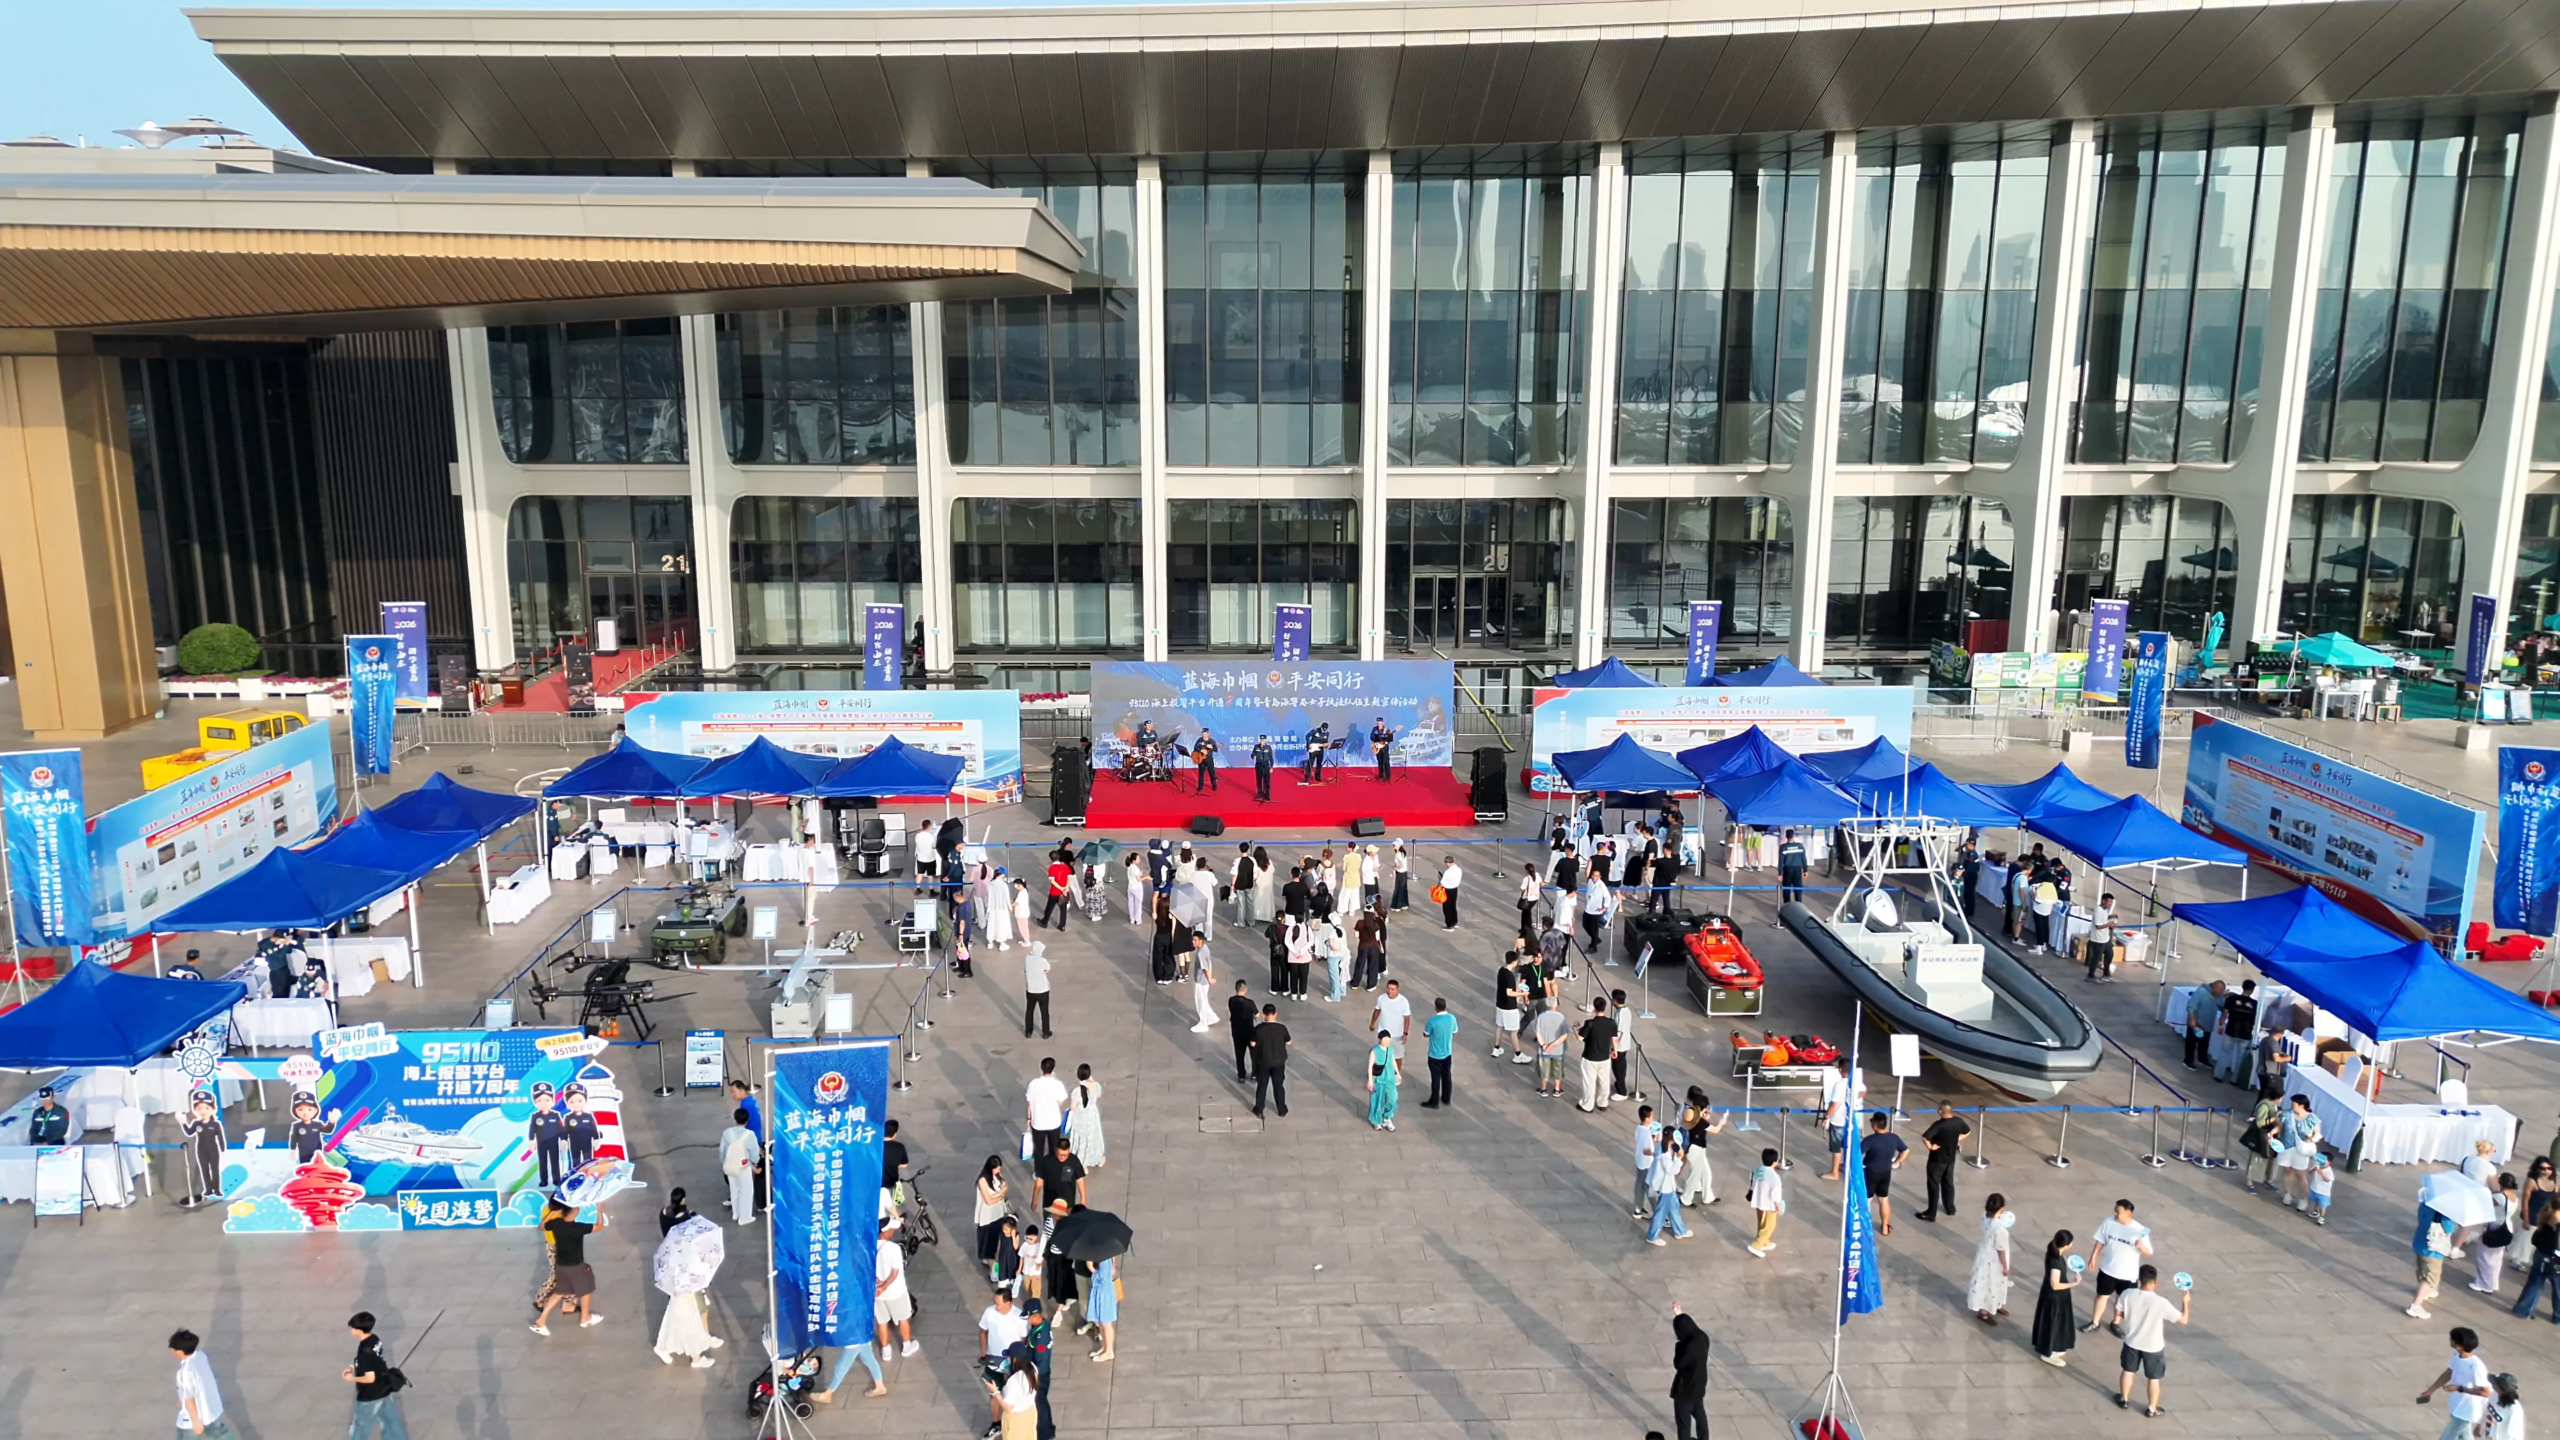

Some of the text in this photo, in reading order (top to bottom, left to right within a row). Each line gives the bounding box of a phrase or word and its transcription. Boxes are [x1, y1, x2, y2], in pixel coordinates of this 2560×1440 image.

[661, 554, 685, 571] 21
[394, 620, 417, 629] 2026
[874, 621, 894, 629] 2026
[1283, 621, 1303, 629] 2026
[1696, 618, 1713, 626] 2026
[2100, 617, 2119, 626] 2026
[1181, 669, 1365, 693] 蓝海巾帼 平安同行
[325, 1026, 379, 1046] 蓝海巾帼
[338, 1039, 392, 1059] 平安同行
[421, 1041, 500, 1064] 95110
[403, 1063, 505, 1081] 海上报警平台
[437, 1079, 520, 1096] 开通7周年
[783, 1104, 867, 1132] 蓝海巾帼
[793, 1125, 876, 1152] 平安同行
[408, 1198, 494, 1226] 中国海警
